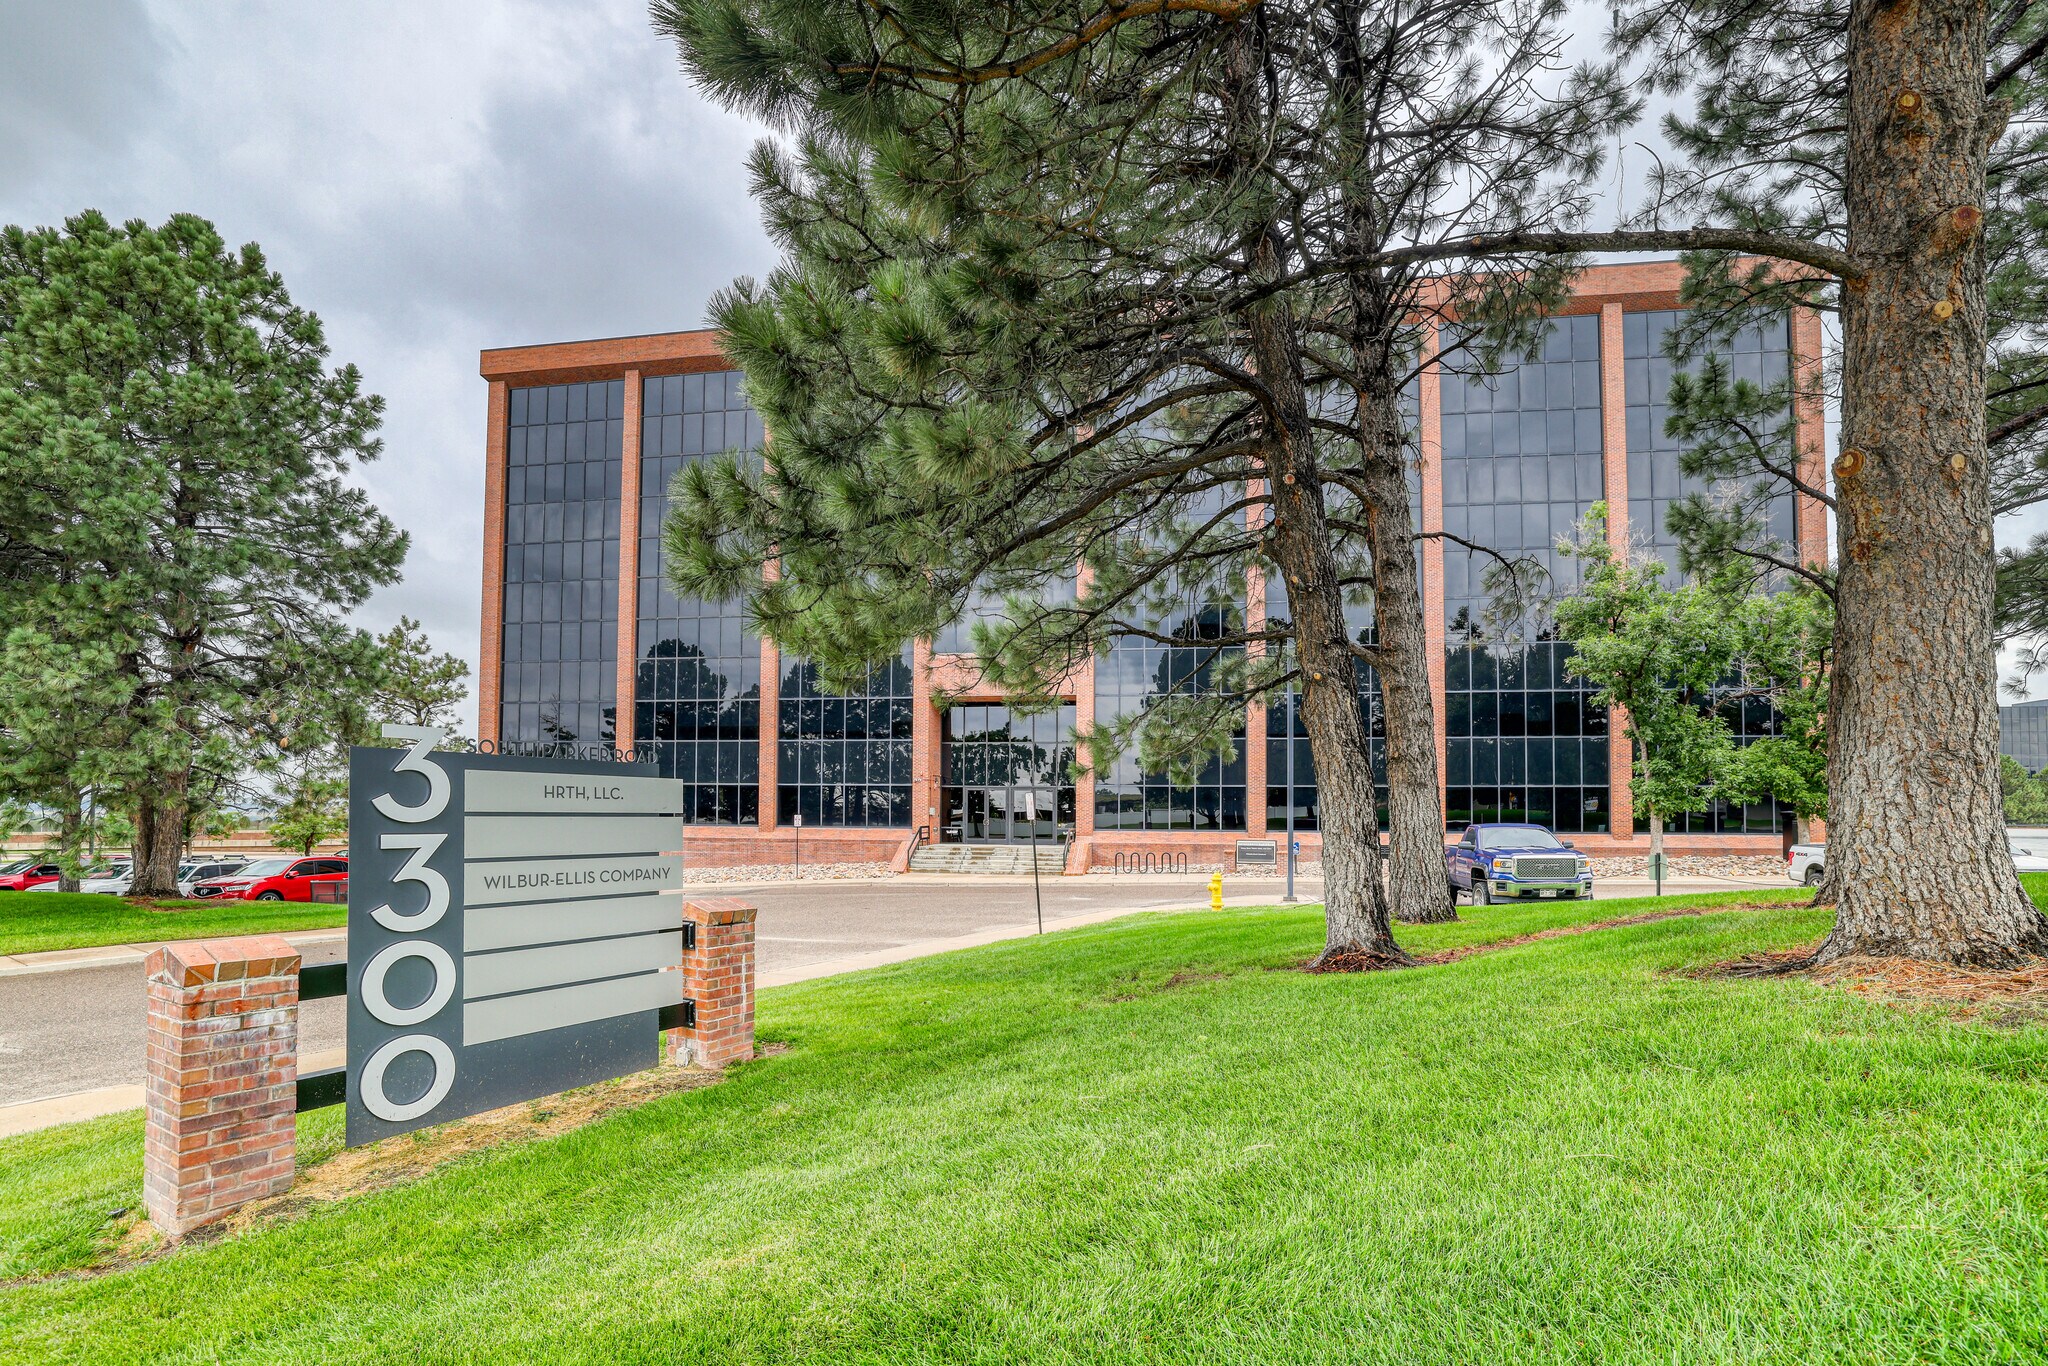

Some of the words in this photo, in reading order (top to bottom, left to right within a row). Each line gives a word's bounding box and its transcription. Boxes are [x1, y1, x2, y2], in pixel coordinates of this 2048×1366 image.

[466, 738, 537, 757] SOUTH
[540, 743, 610, 762] PARKER
[613, 748, 659, 764] ROAD
[544, 785, 589, 801] HRTH,
[594, 787, 624, 800] LLC.
[483, 871, 596, 890] WILBUR-ELLIS
[600, 867, 671, 883] COMPANY
[360, 723, 457, 1122] 3300
